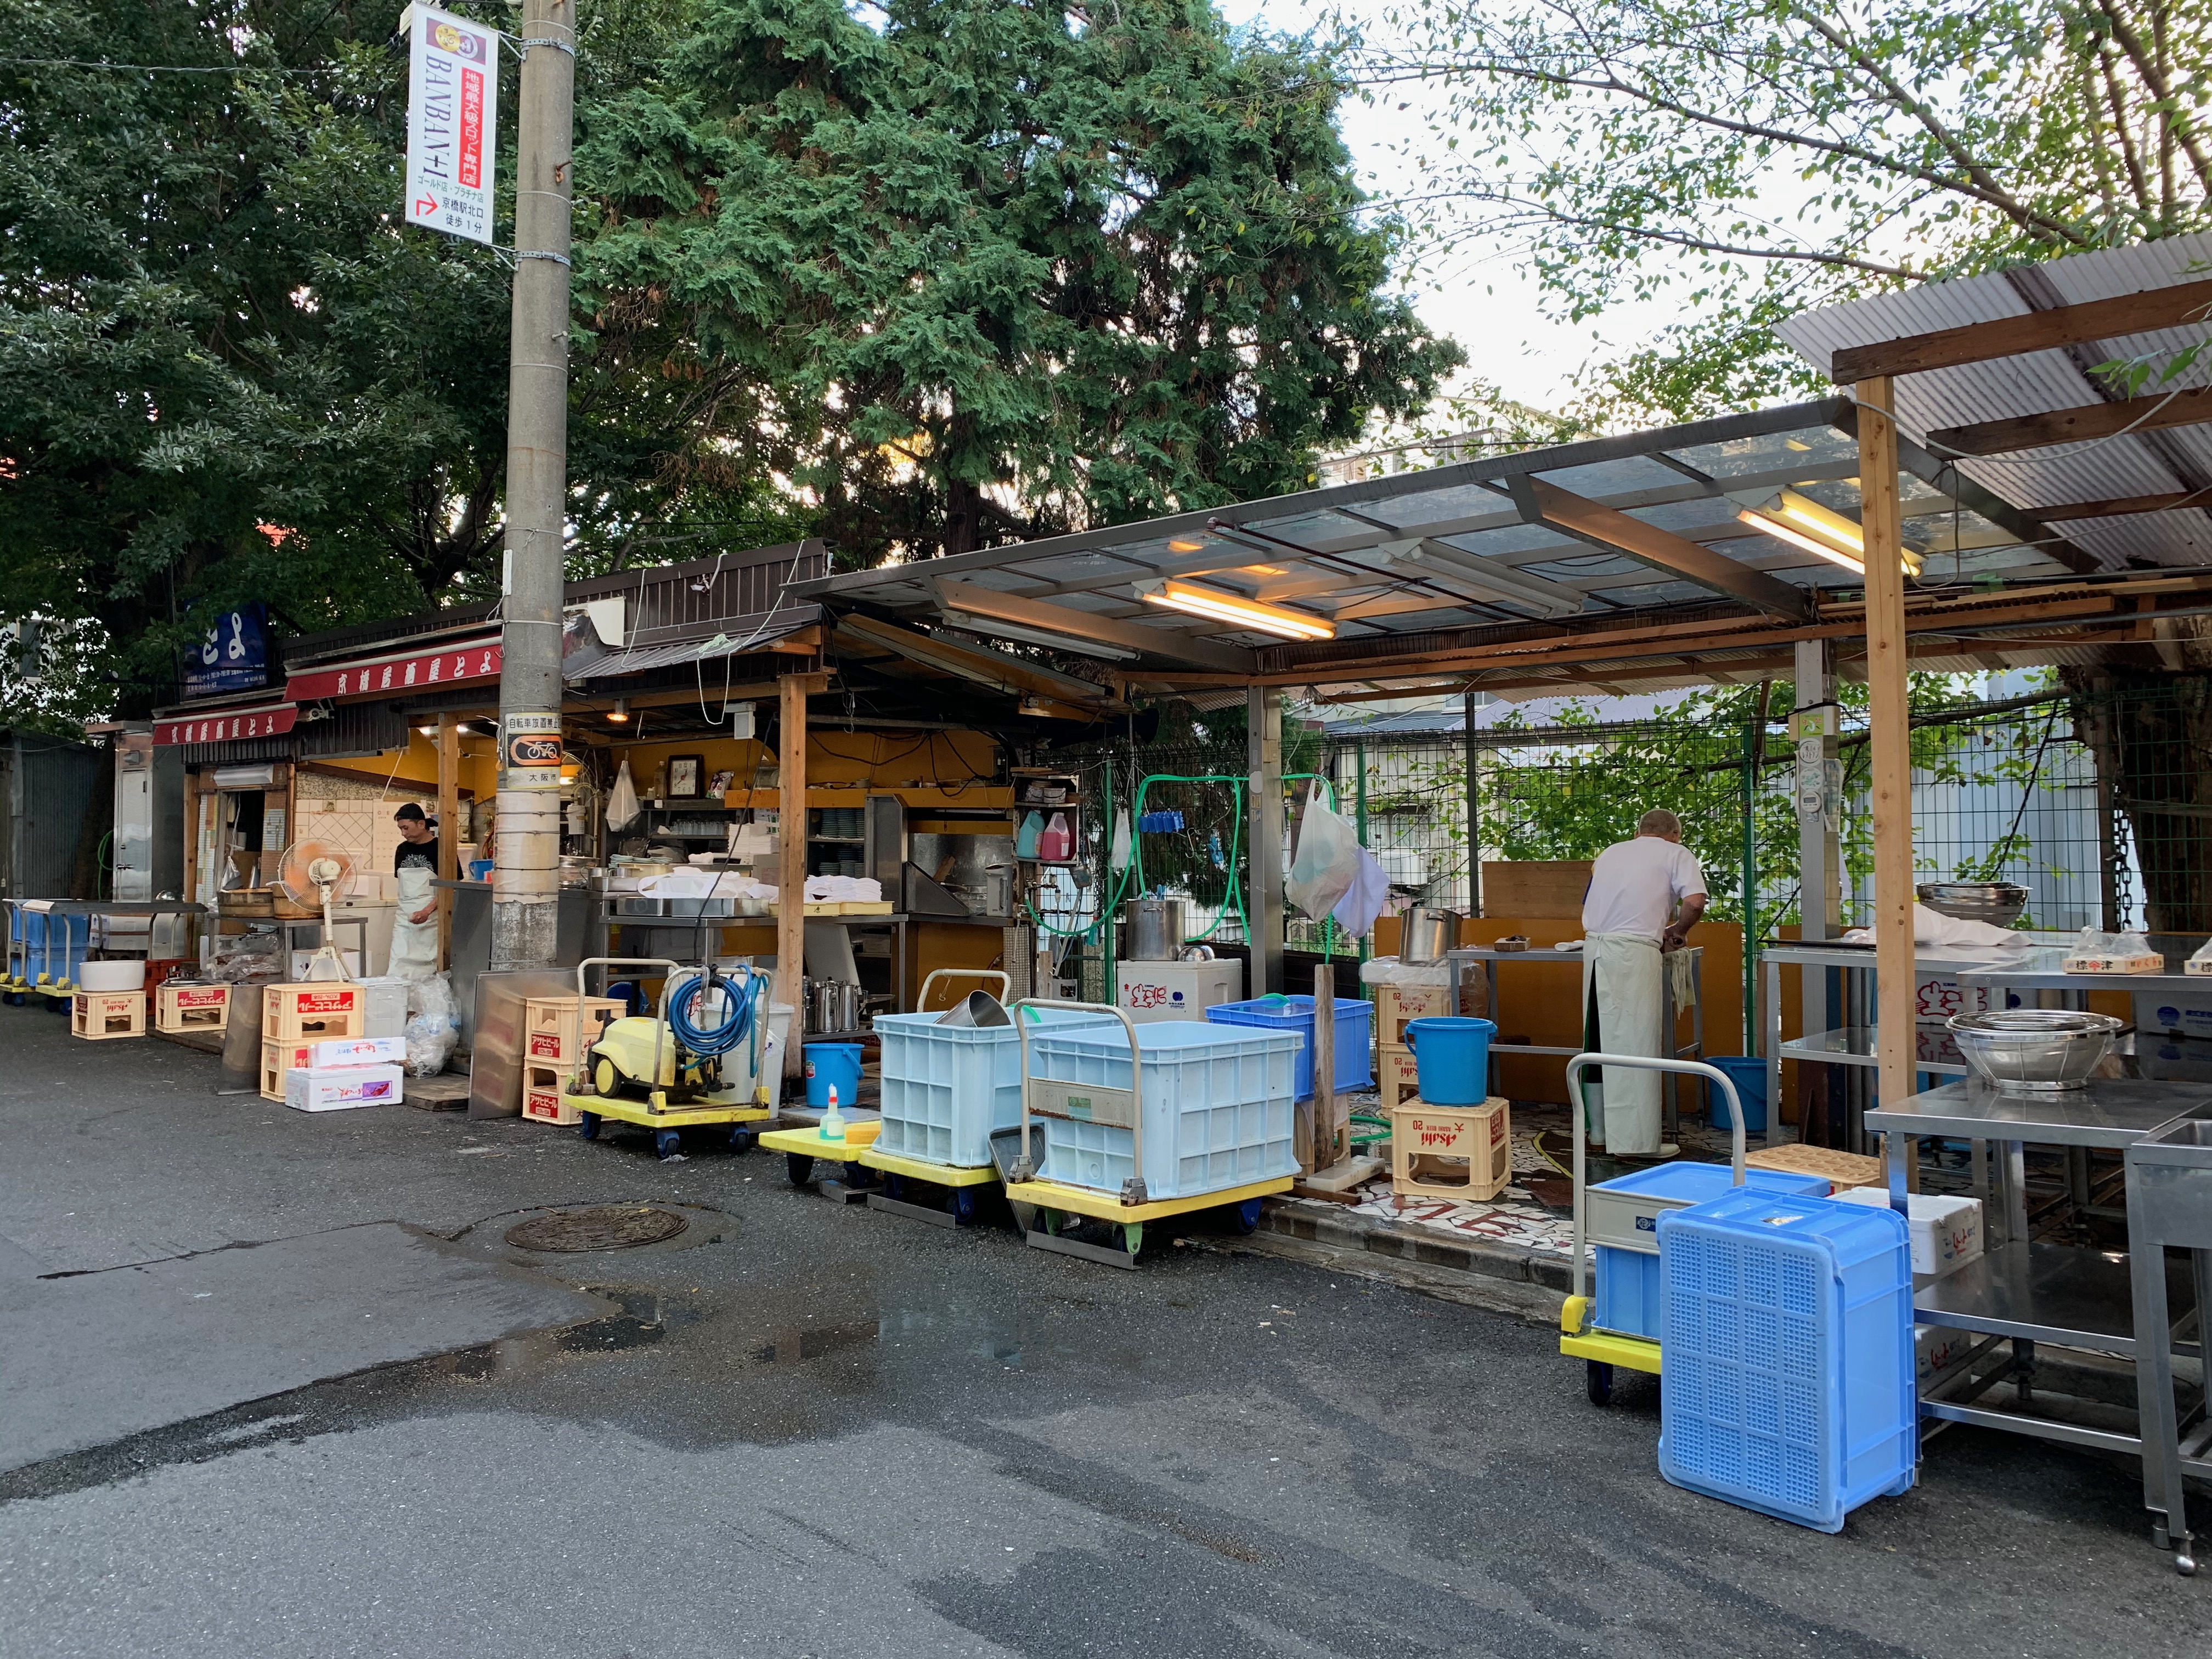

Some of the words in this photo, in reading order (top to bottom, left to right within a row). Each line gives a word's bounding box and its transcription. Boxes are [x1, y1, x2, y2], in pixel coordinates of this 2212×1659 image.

[424, 53, 452, 178] BANBAN+1
[461, 70, 479, 185] 地域最大級スロット専門店
[417, 175, 484, 204] ゴールド店・プラチナ店
[442, 197, 483, 218] 京橋駅北口
[202, 612, 245, 664] とよ
[337, 651, 491, 695] 京橋居酒屋とよ
[171, 715, 273, 743] 京橋居酒屋とよ
[179, 996, 224, 1006] アサヒビール
[298, 1000, 352, 1012] アサヒビール
[532, 1036, 560, 1048] アサヒビール
[530, 1094, 557, 1108] アサヒビール
[1413, 1120, 1423, 1130] 20
[1454, 1122, 1464, 1132] 大
[1421, 1132, 1457, 1147] Asahi
